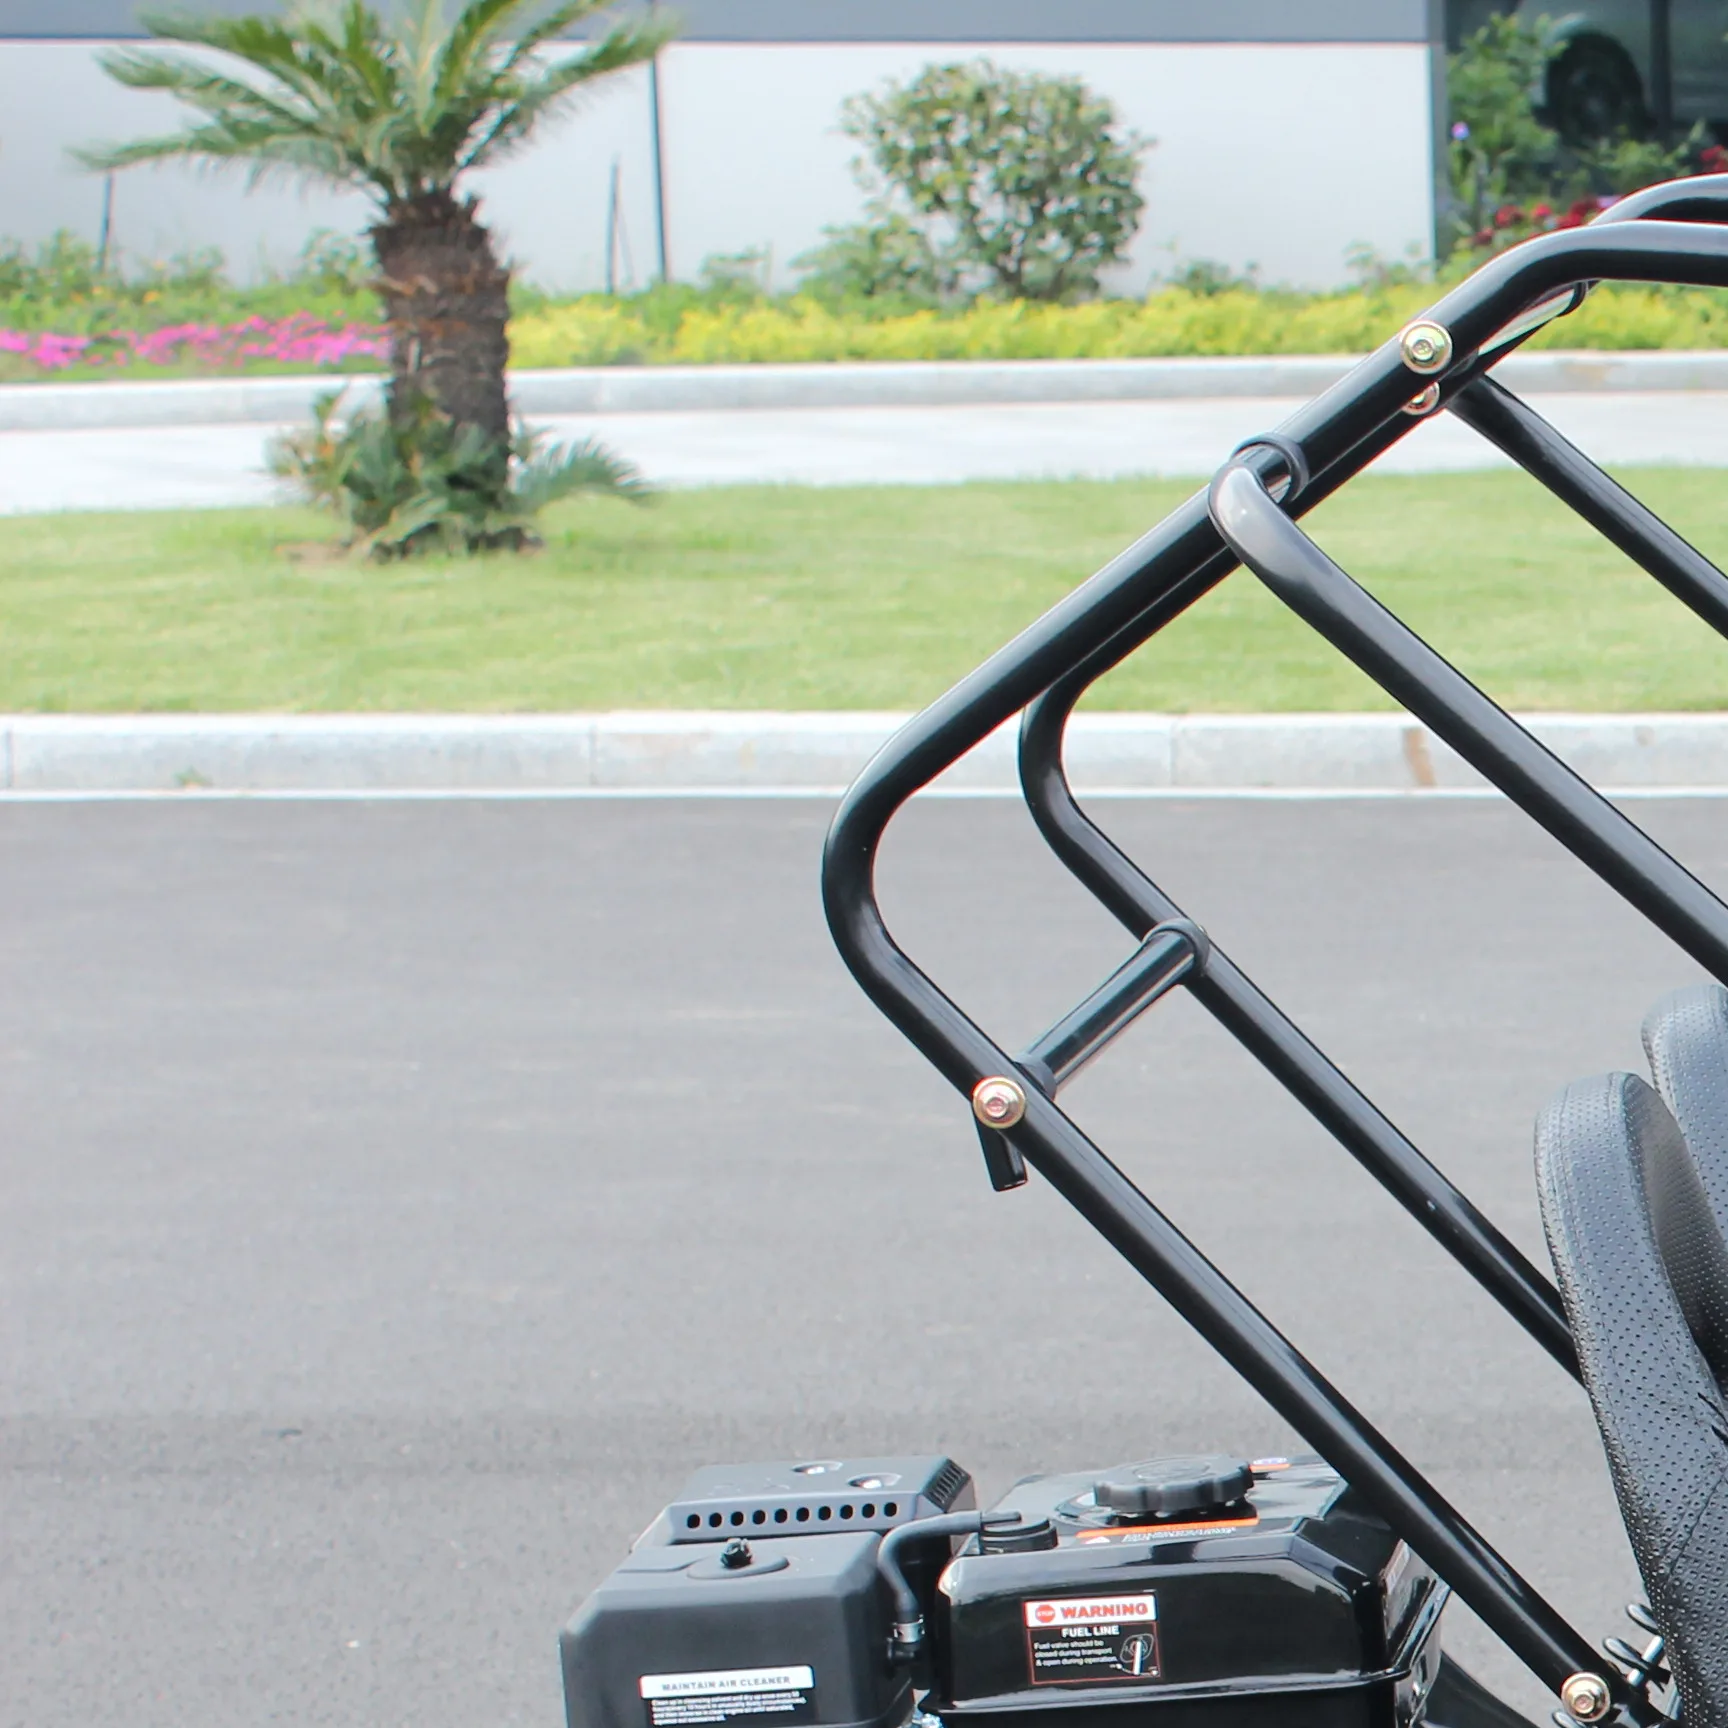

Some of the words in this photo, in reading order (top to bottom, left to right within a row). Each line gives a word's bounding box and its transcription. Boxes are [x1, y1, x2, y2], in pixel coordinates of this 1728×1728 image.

[1060, 1603, 1148, 1619] WARNING
[1061, 1627, 1092, 1638] FUEL
[1093, 1625, 1120, 1636] LINE
[662, 1682, 715, 1691] MAINTAIN
[718, 1680, 737, 1688] AIR
[740, 1676, 791, 1687] CLEANER
